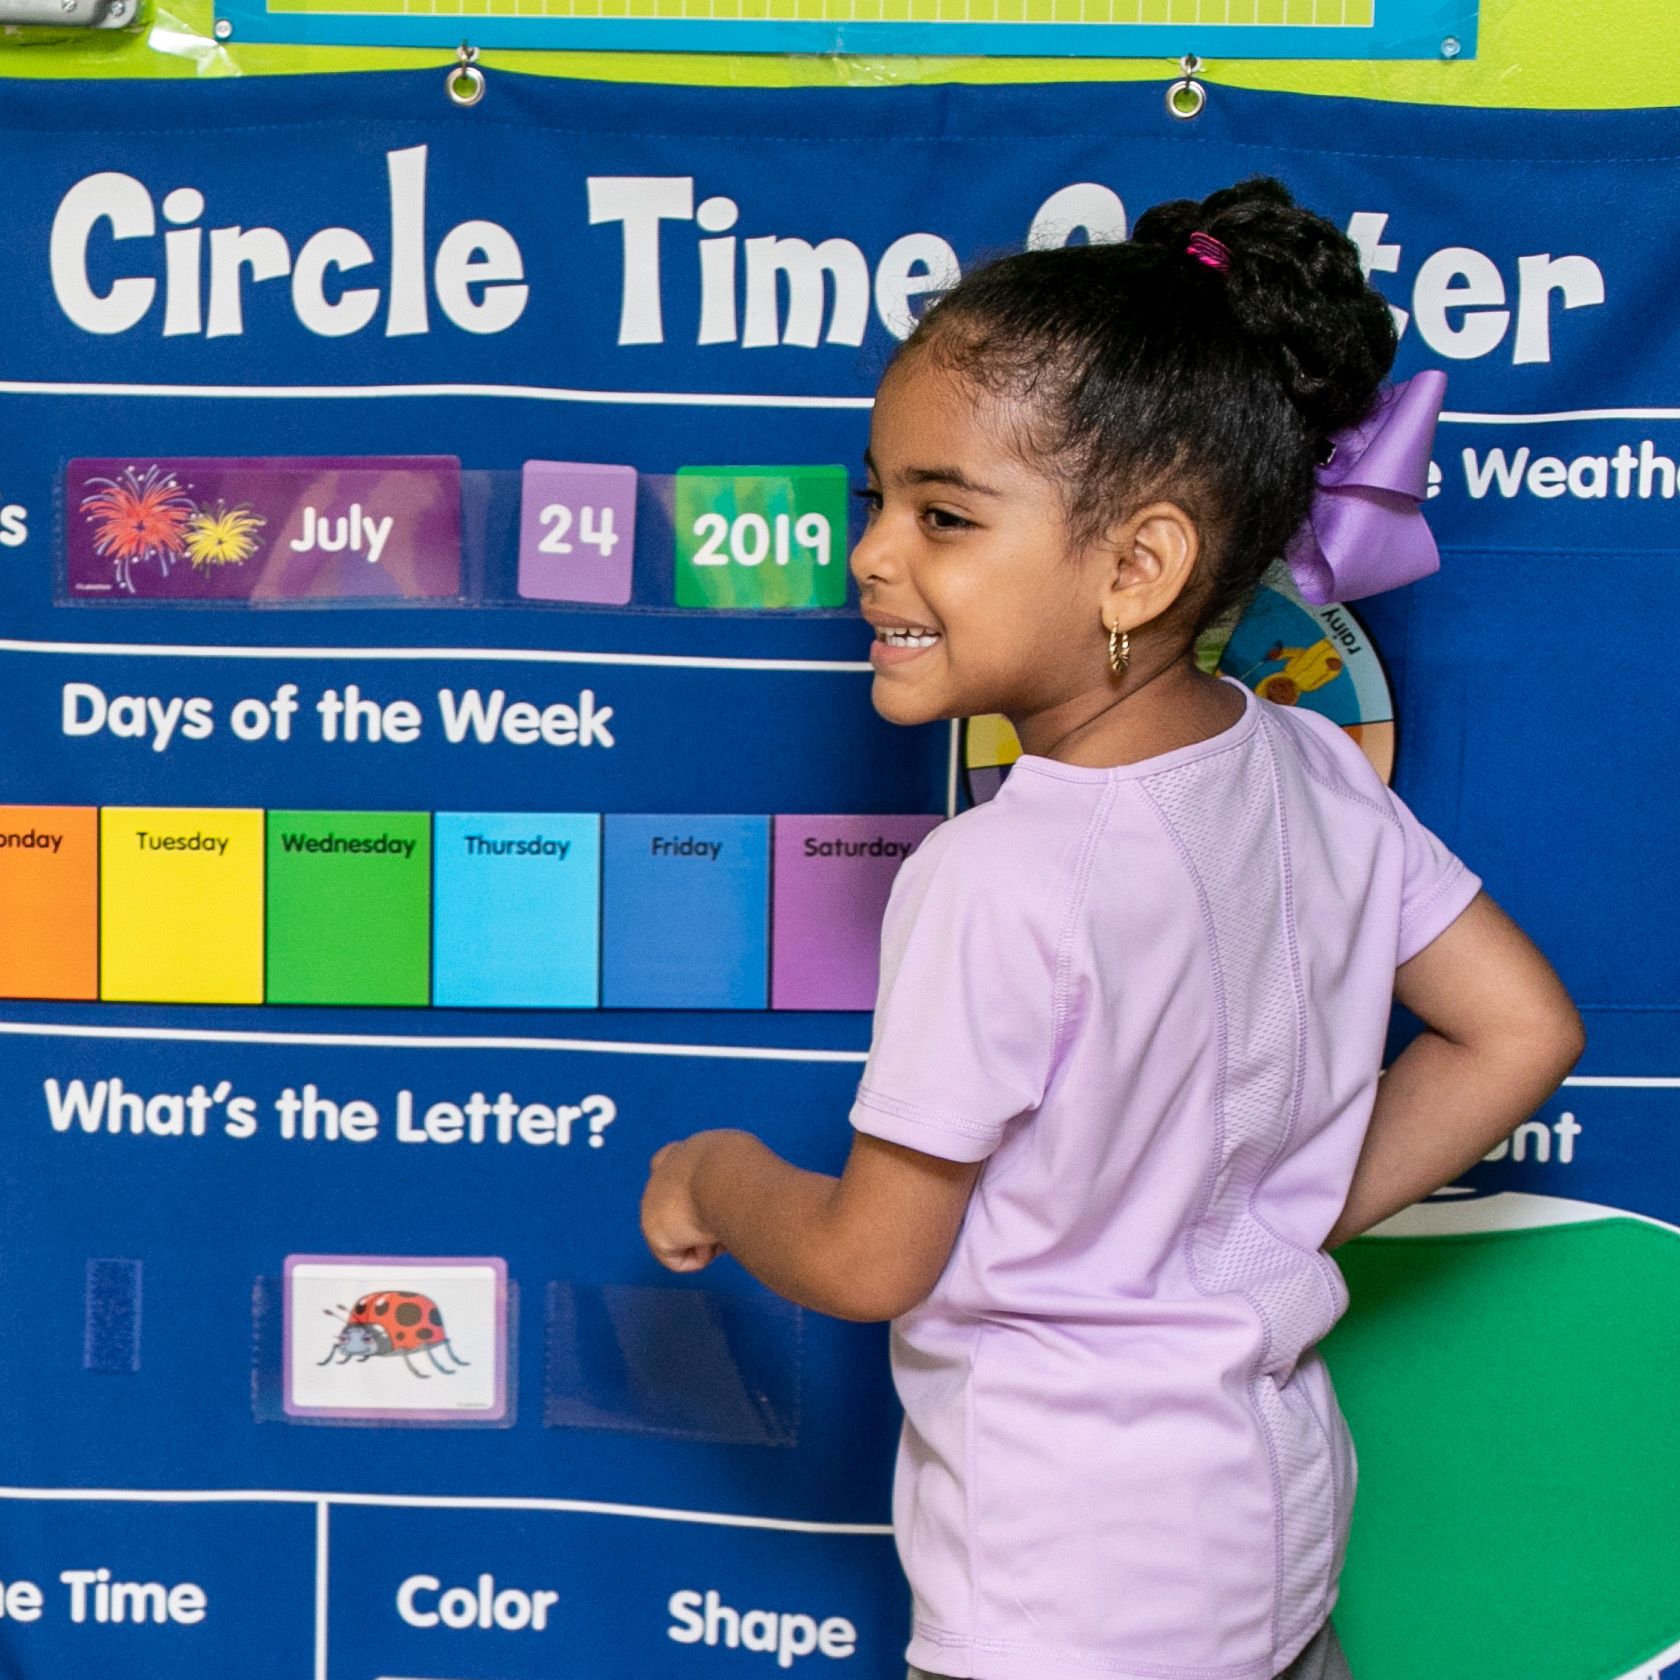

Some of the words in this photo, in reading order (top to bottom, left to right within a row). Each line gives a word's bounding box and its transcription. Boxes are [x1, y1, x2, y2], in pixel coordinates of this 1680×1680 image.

[50, 145, 528, 338] Circle
[586, 176, 960, 348] Time
[1463, 440, 1680, 498] Weath
[290, 504, 393, 562] July
[540, 505, 617, 555] 24
[694, 514, 829, 565] 2019
[1321, 607, 1363, 655] rainy
[63, 683, 213, 751] Days
[231, 684, 298, 740] of
[317, 685, 421, 742] the
[439, 689, 614, 747] Week
[137, 832, 228, 855] Tuesday
[282, 834, 415, 858] Wednesday
[465, 835, 569, 860] Thursday
[653, 837, 722, 860] Friday
[806, 837, 912, 861] Saturday
[45, 1078, 256, 1138] What's
[275, 1084, 378, 1141] the
[397, 1090, 616, 1147] Letter?
[60, 1568, 206, 1624] Time
[397, 1574, 558, 1630] Color
[669, 1591, 856, 1667] Shape
